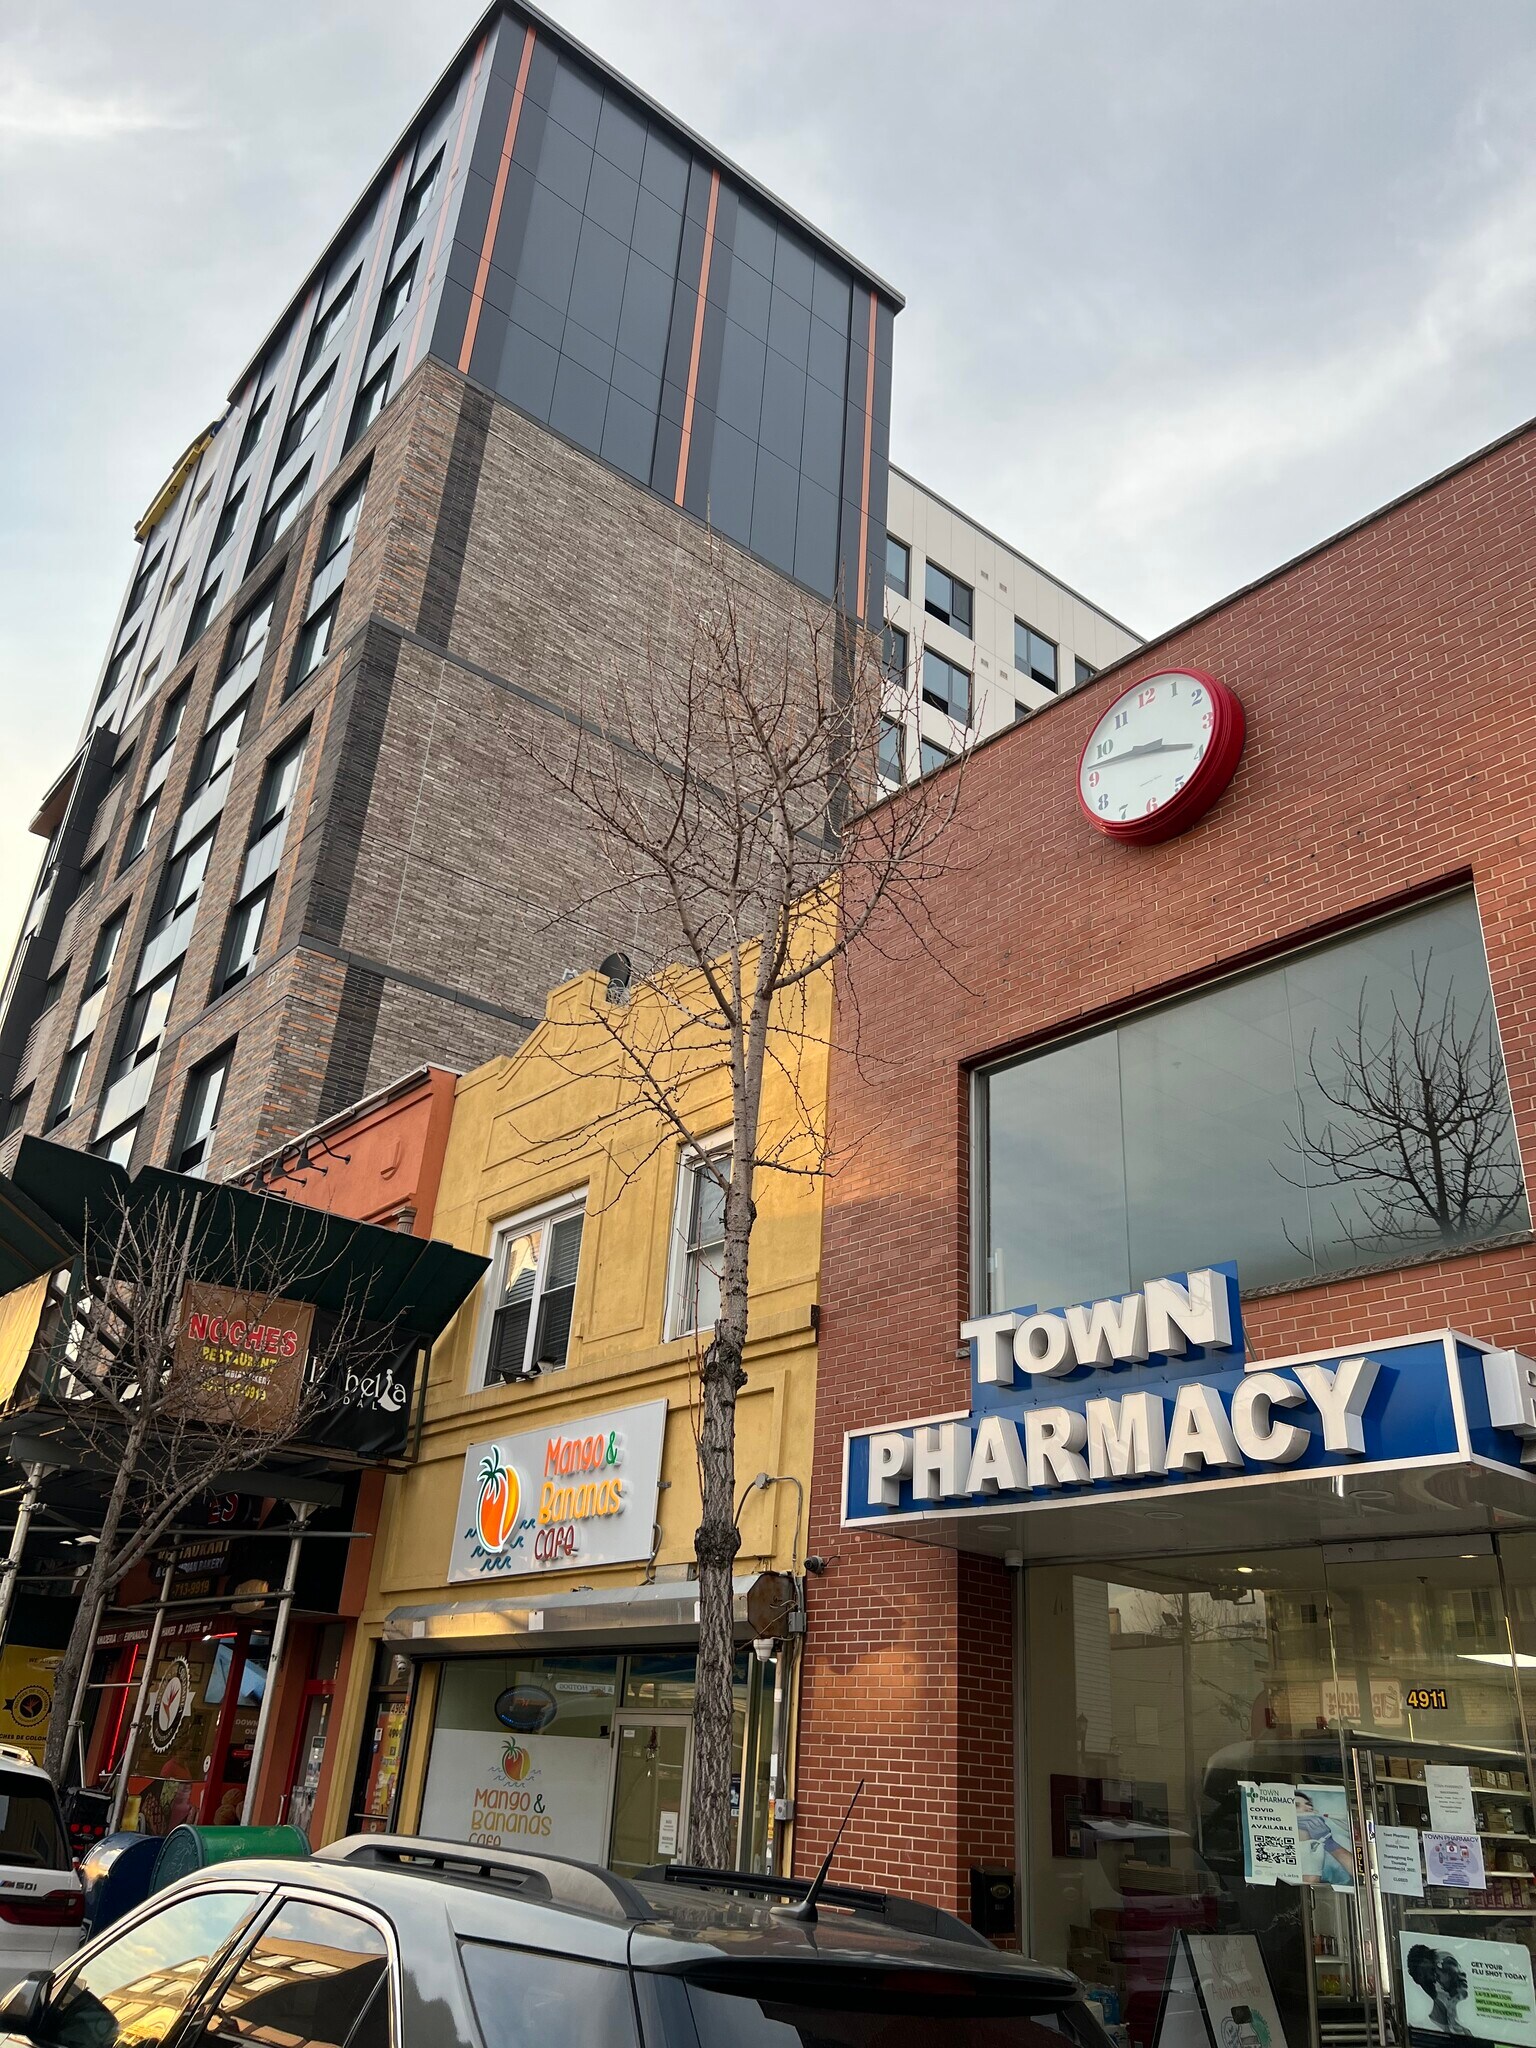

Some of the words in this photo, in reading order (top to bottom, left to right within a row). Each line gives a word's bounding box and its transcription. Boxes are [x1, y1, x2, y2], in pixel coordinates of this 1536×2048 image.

[1137, 687, 1156, 708] 12
[1171, 682, 1178, 697] 1
[1191, 689, 1203, 706] 2
[1115, 711, 1128, 730] 11
[1202, 711, 1213, 729] 3
[1097, 739, 1114, 759] 10
[1193, 744, 1204, 761] 4
[1089, 771, 1100, 787] 9
[1175, 775, 1185, 793] 5
[1098, 794, 1109, 810] 8
[1146, 797, 1158, 813] 6
[1119, 804, 1128, 820] 7
[188, 1312, 298, 1357] NOCHES
[960, 1268, 1233, 1387] TOWN
[867, 1357, 1382, 1507] PHARMACY
[544, 1433, 605, 1478] Mango
[537, 1478, 623, 1525] Bananas
[1407, 1689, 1447, 1709] 4911
[474, 1787, 531, 1812] Mango
[533, 1793, 546, 1814] &
[471, 1810, 552, 1837] Bananas
[1356, 1847, 1364, 1873] PULL
[1485, 1970, 1502, 1978] SHOT
[1504, 1972, 1527, 1981] TODAY
